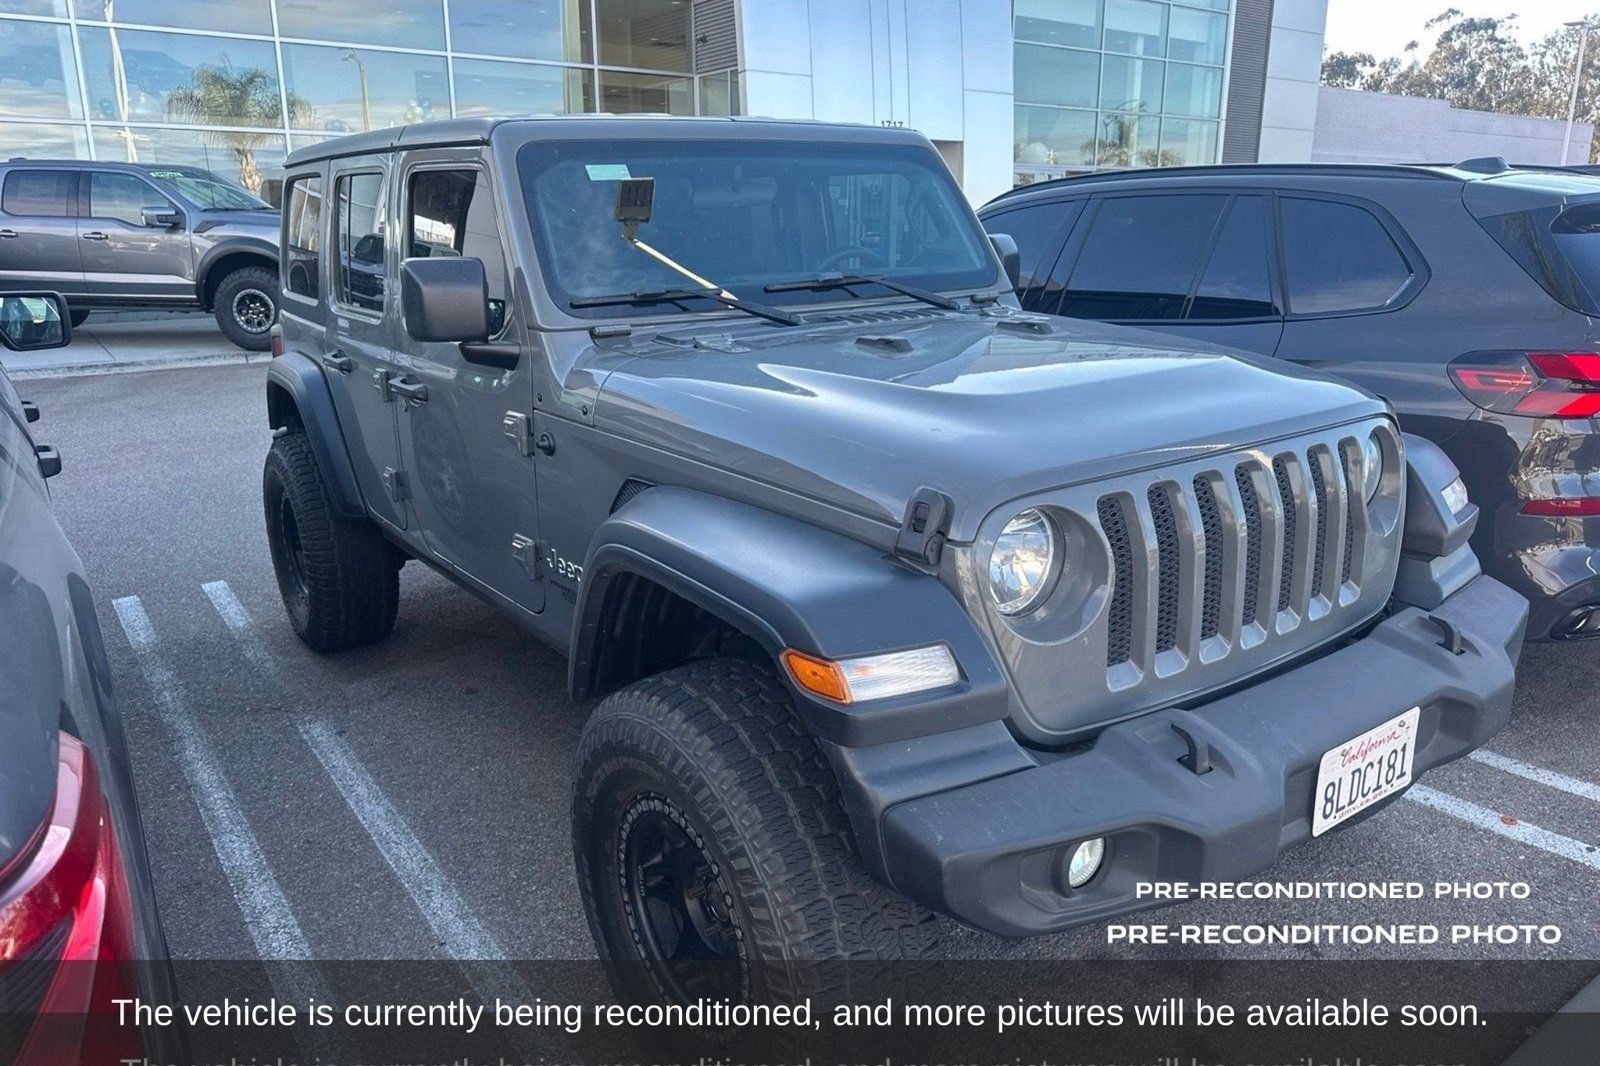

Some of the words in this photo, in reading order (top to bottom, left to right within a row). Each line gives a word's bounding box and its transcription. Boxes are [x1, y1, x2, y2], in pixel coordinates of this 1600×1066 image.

[880, 120, 903, 128] 1717
[1341, 731, 1401, 768] California
[1322, 742, 1407, 820] 8LDC181
